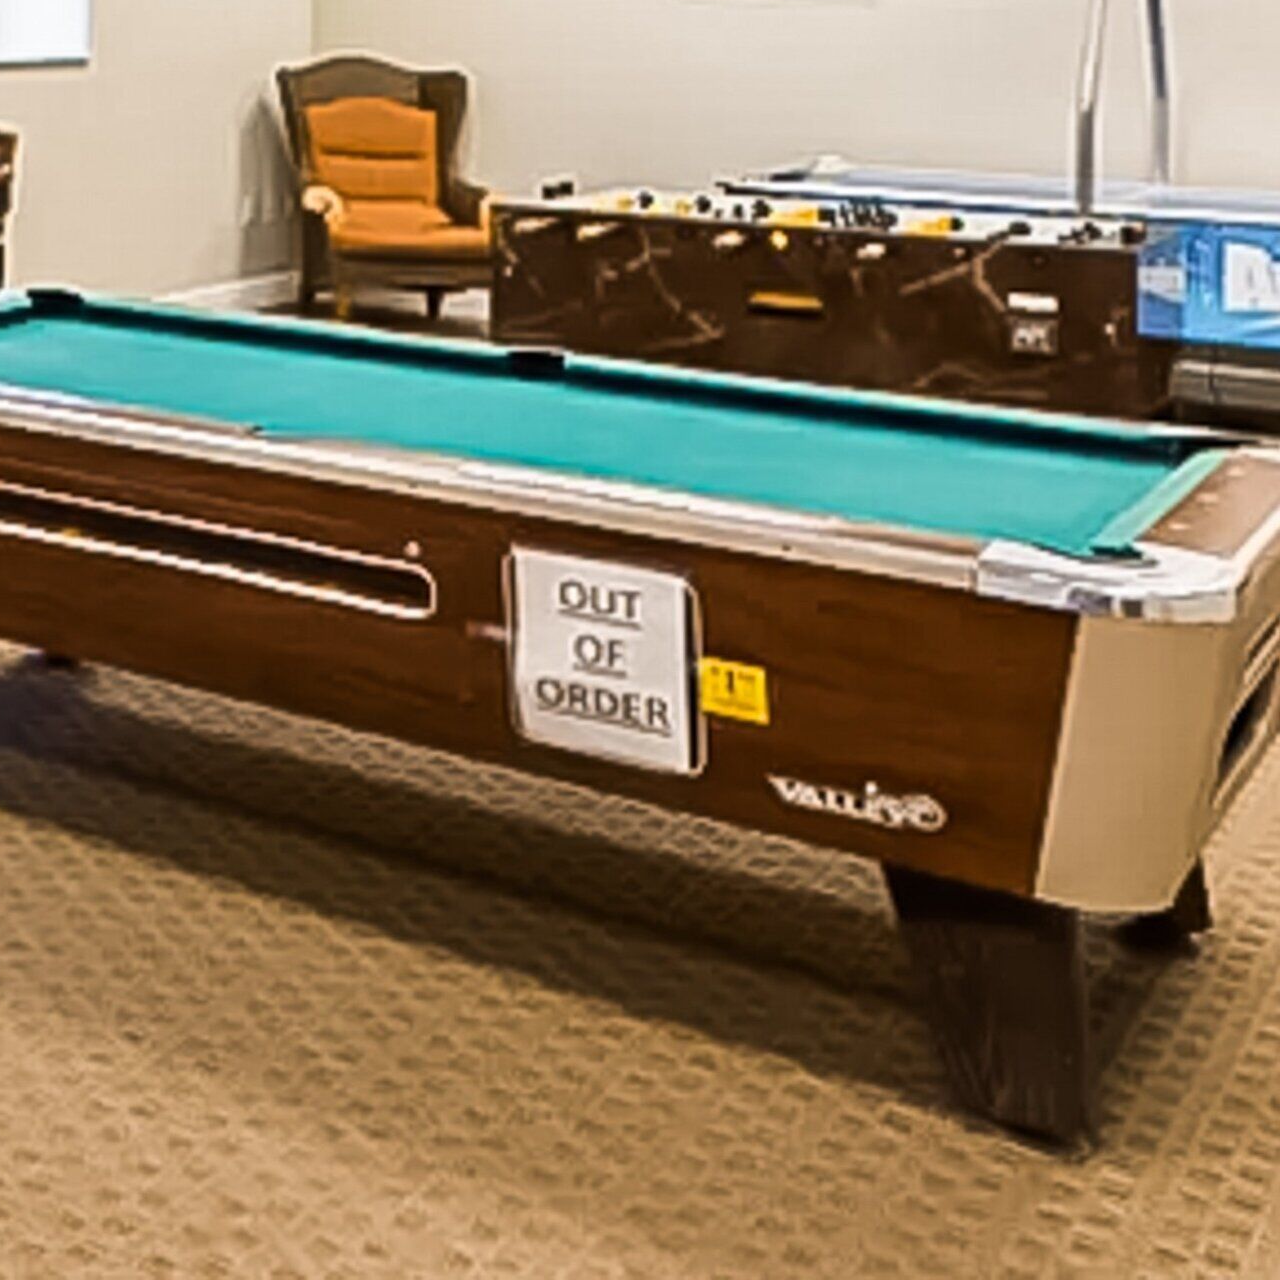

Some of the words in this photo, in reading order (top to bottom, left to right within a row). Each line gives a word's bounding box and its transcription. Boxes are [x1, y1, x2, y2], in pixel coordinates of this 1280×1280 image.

[559, 578, 641, 620] OUT
[574, 633, 627, 670] OF
[536, 677, 670, 731] ORDER
